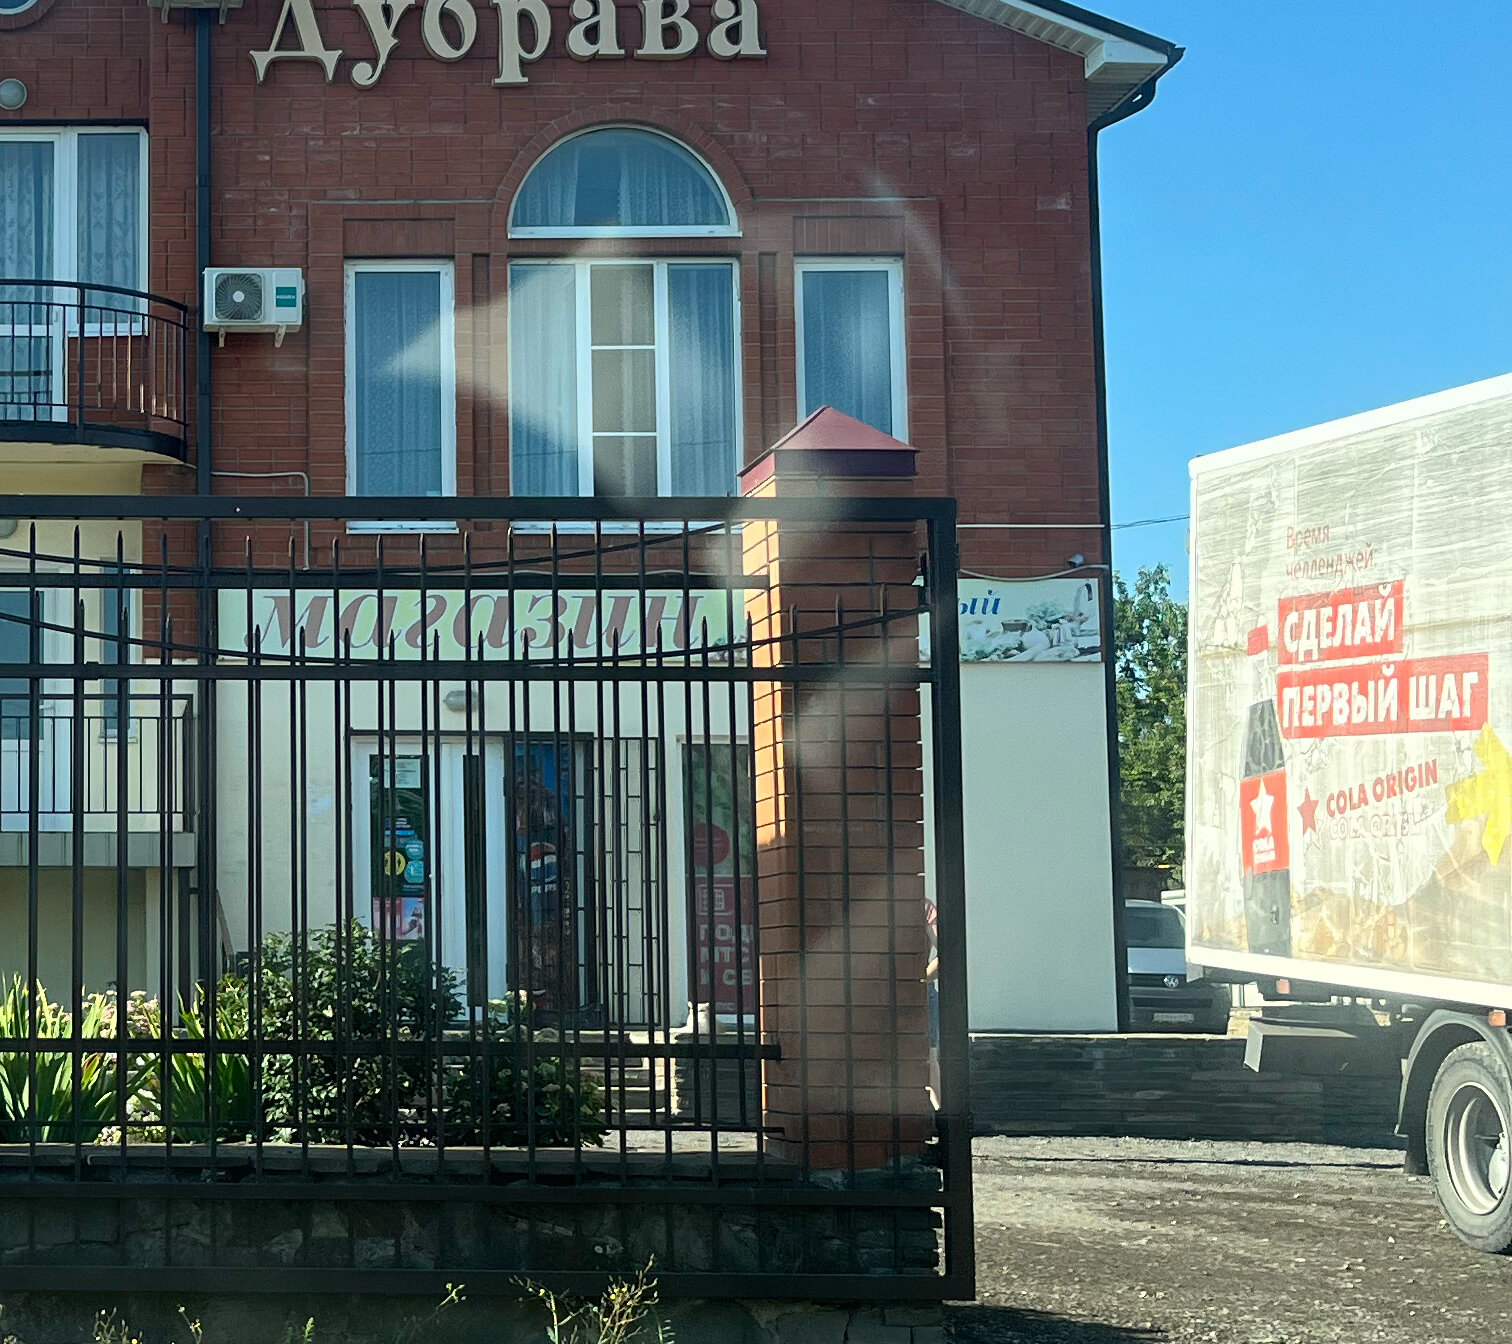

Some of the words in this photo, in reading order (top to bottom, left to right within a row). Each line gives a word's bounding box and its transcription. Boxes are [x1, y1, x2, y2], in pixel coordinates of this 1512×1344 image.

[1283, 583, 1395, 662] СДЕЛАЙ
[1282, 664, 1399, 729] ПЕРВЫЙ
[1408, 671, 1479, 721] ШАГ
[1326, 783, 1369, 819] COLA
[1372, 758, 1438, 803] ORIGIN
